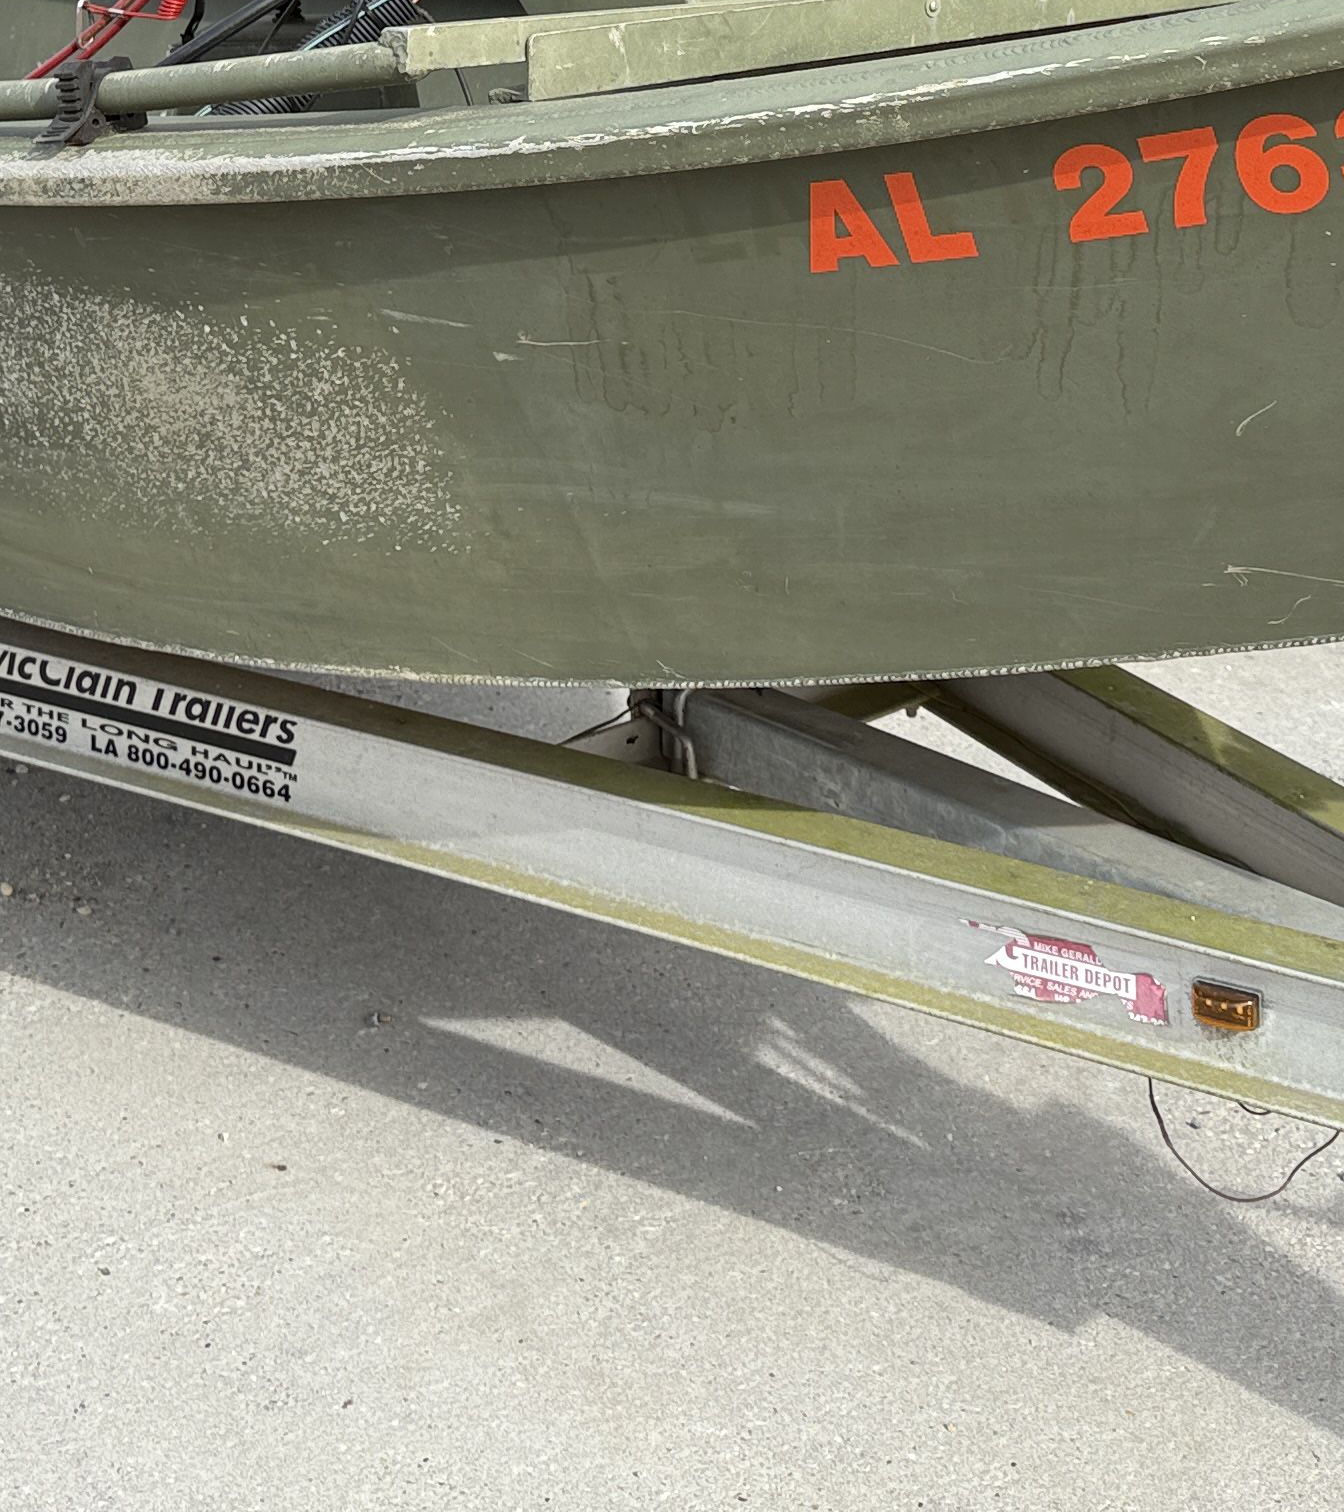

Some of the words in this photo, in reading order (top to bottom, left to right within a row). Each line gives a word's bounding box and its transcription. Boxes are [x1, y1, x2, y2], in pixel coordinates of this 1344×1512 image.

[809, 173, 980, 273] AL
[22, 702, 70, 723] THE
[81, 718, 178, 752] LONG
[90, 734, 119, 757] LA
[127, 744, 291, 803] 800-490-0664
[1022, 953, 1079, 982] TRAILER
[1085, 967, 1131, 994] DEPOT
[1047, 981, 1077, 996] SALES
